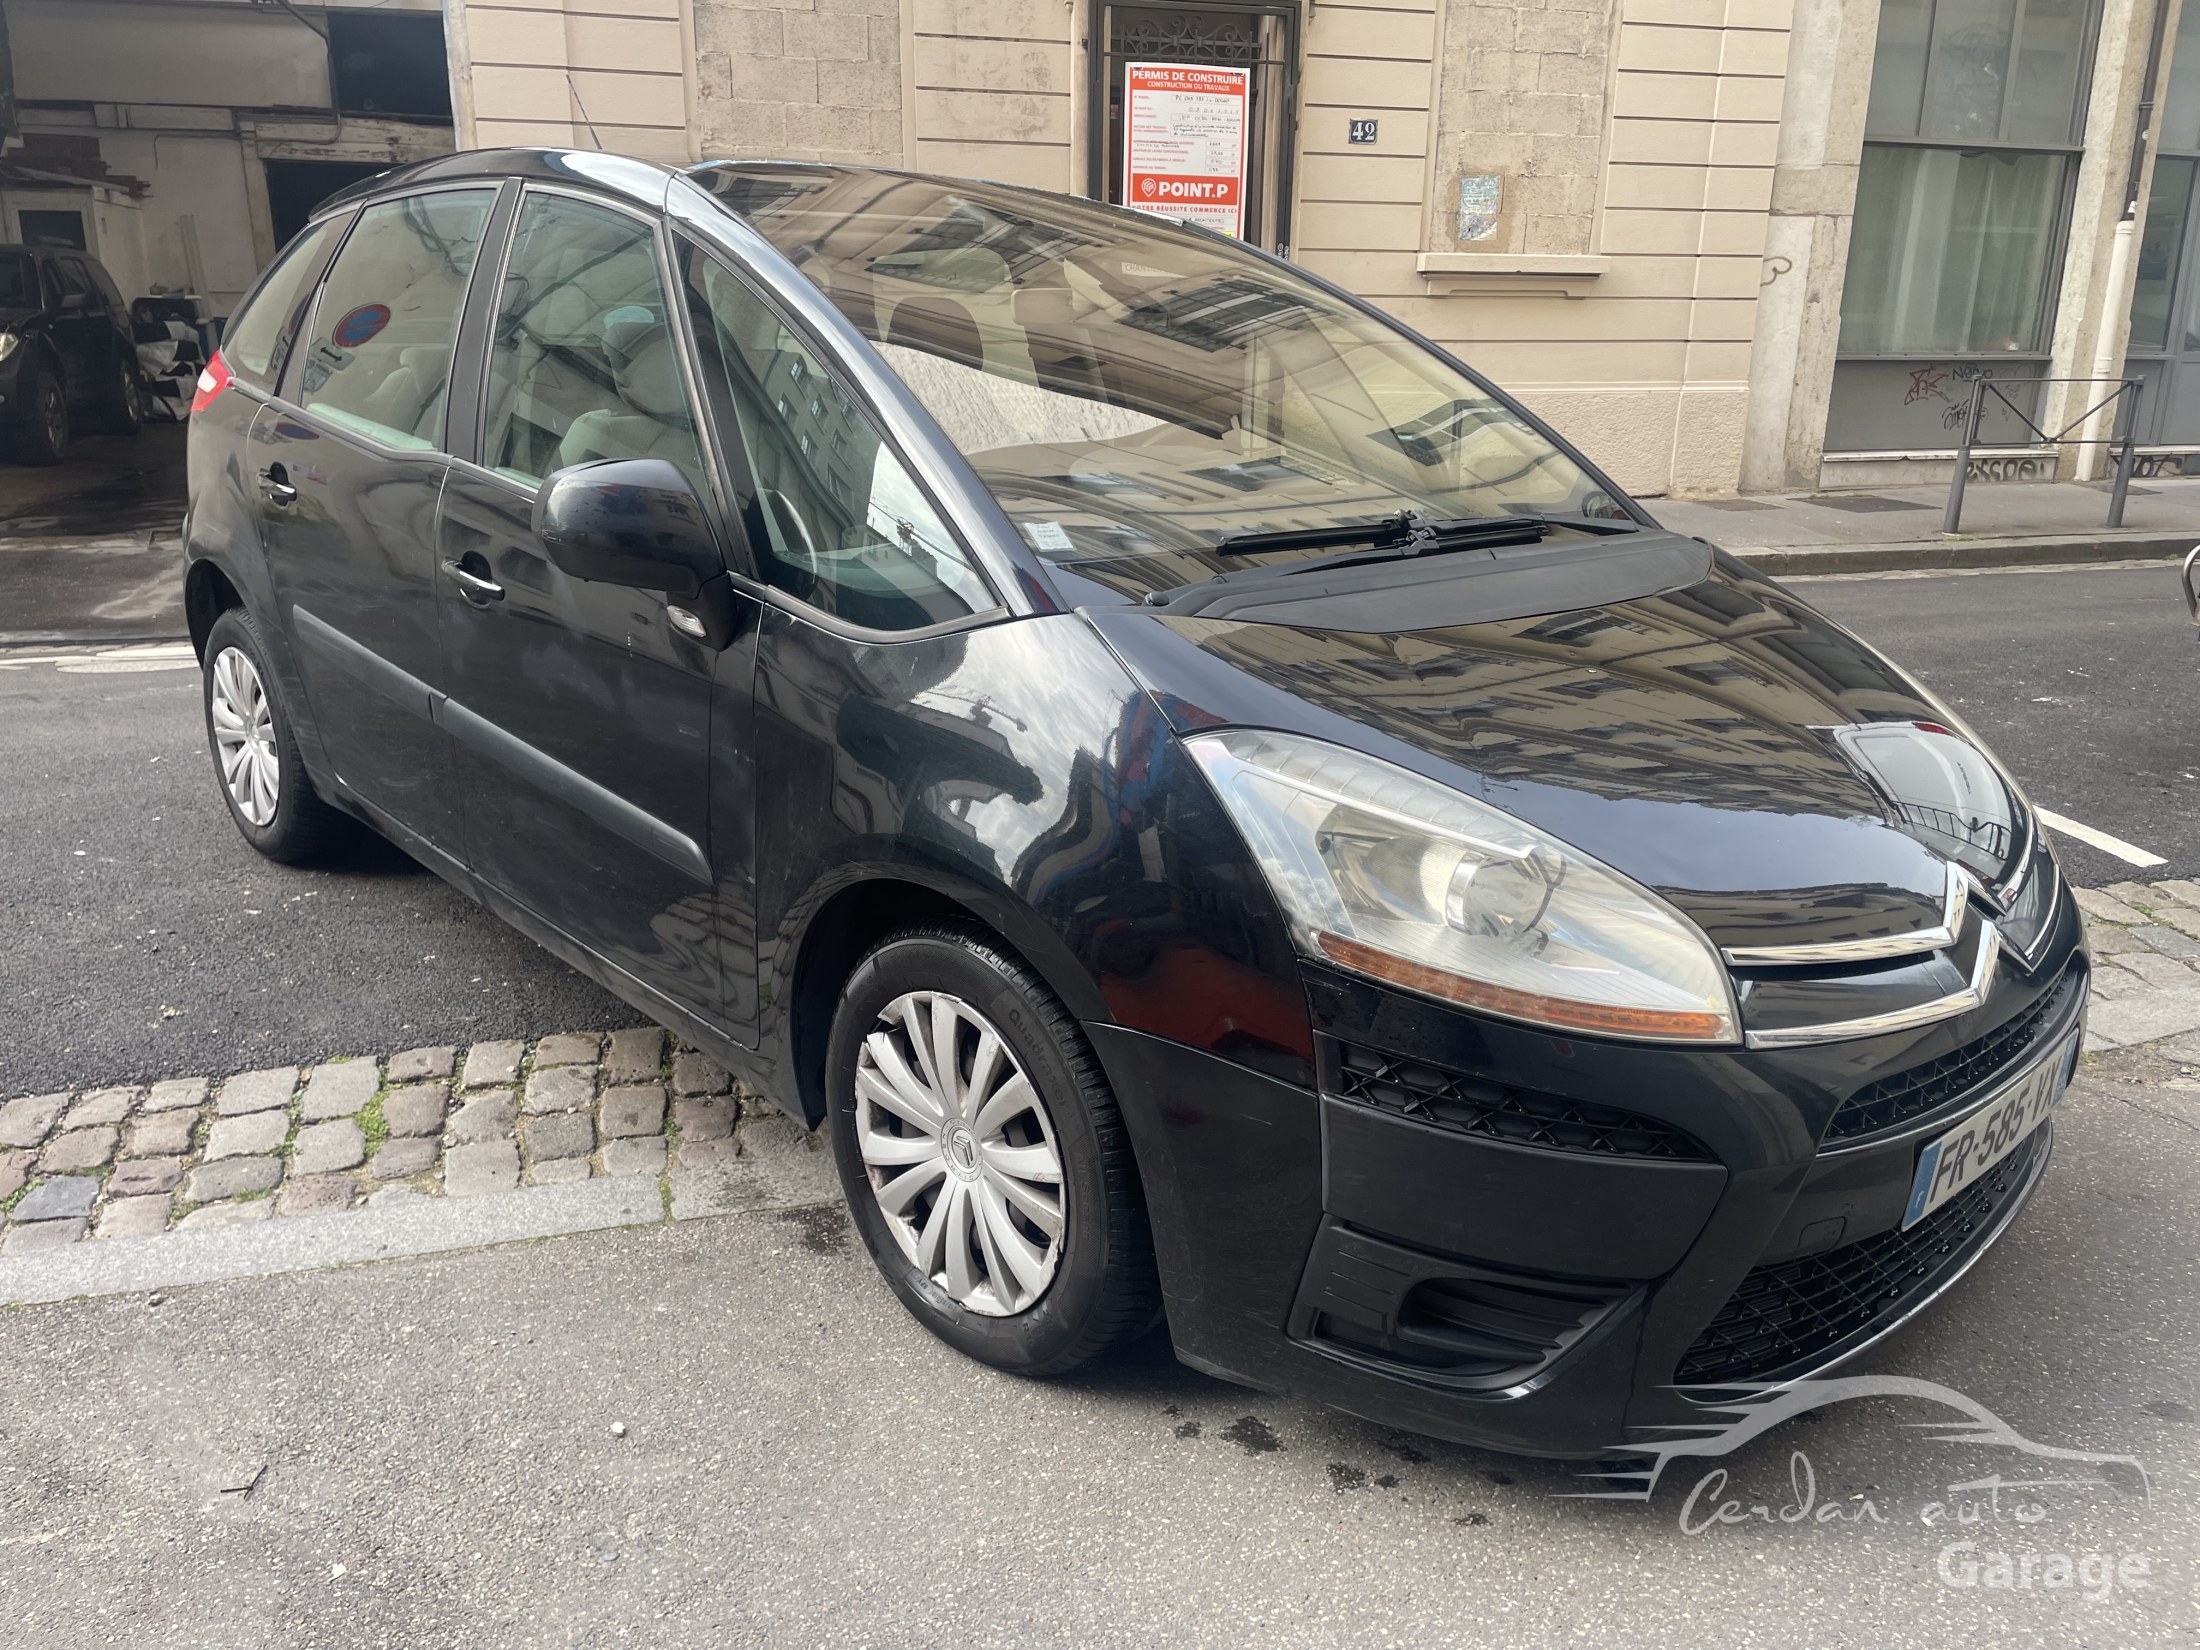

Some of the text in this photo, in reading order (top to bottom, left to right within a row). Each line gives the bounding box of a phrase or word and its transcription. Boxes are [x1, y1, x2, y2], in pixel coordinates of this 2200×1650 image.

[1132, 70, 1243, 85] PERMIS DE CONSTRUIRE
[1147, 81, 1193, 89] CONSTRUCTION
[1352, 122, 1375, 140] 42
[1158, 181, 1229, 198] POINT.P
[1156, 204, 1187, 212] RÉUSSITE
[1190, 206, 1226, 214] COMMENCE
[1009, 1009, 1068, 1109] Quadraxer
[1930, 1058, 2061, 1203] FR-585-VX
